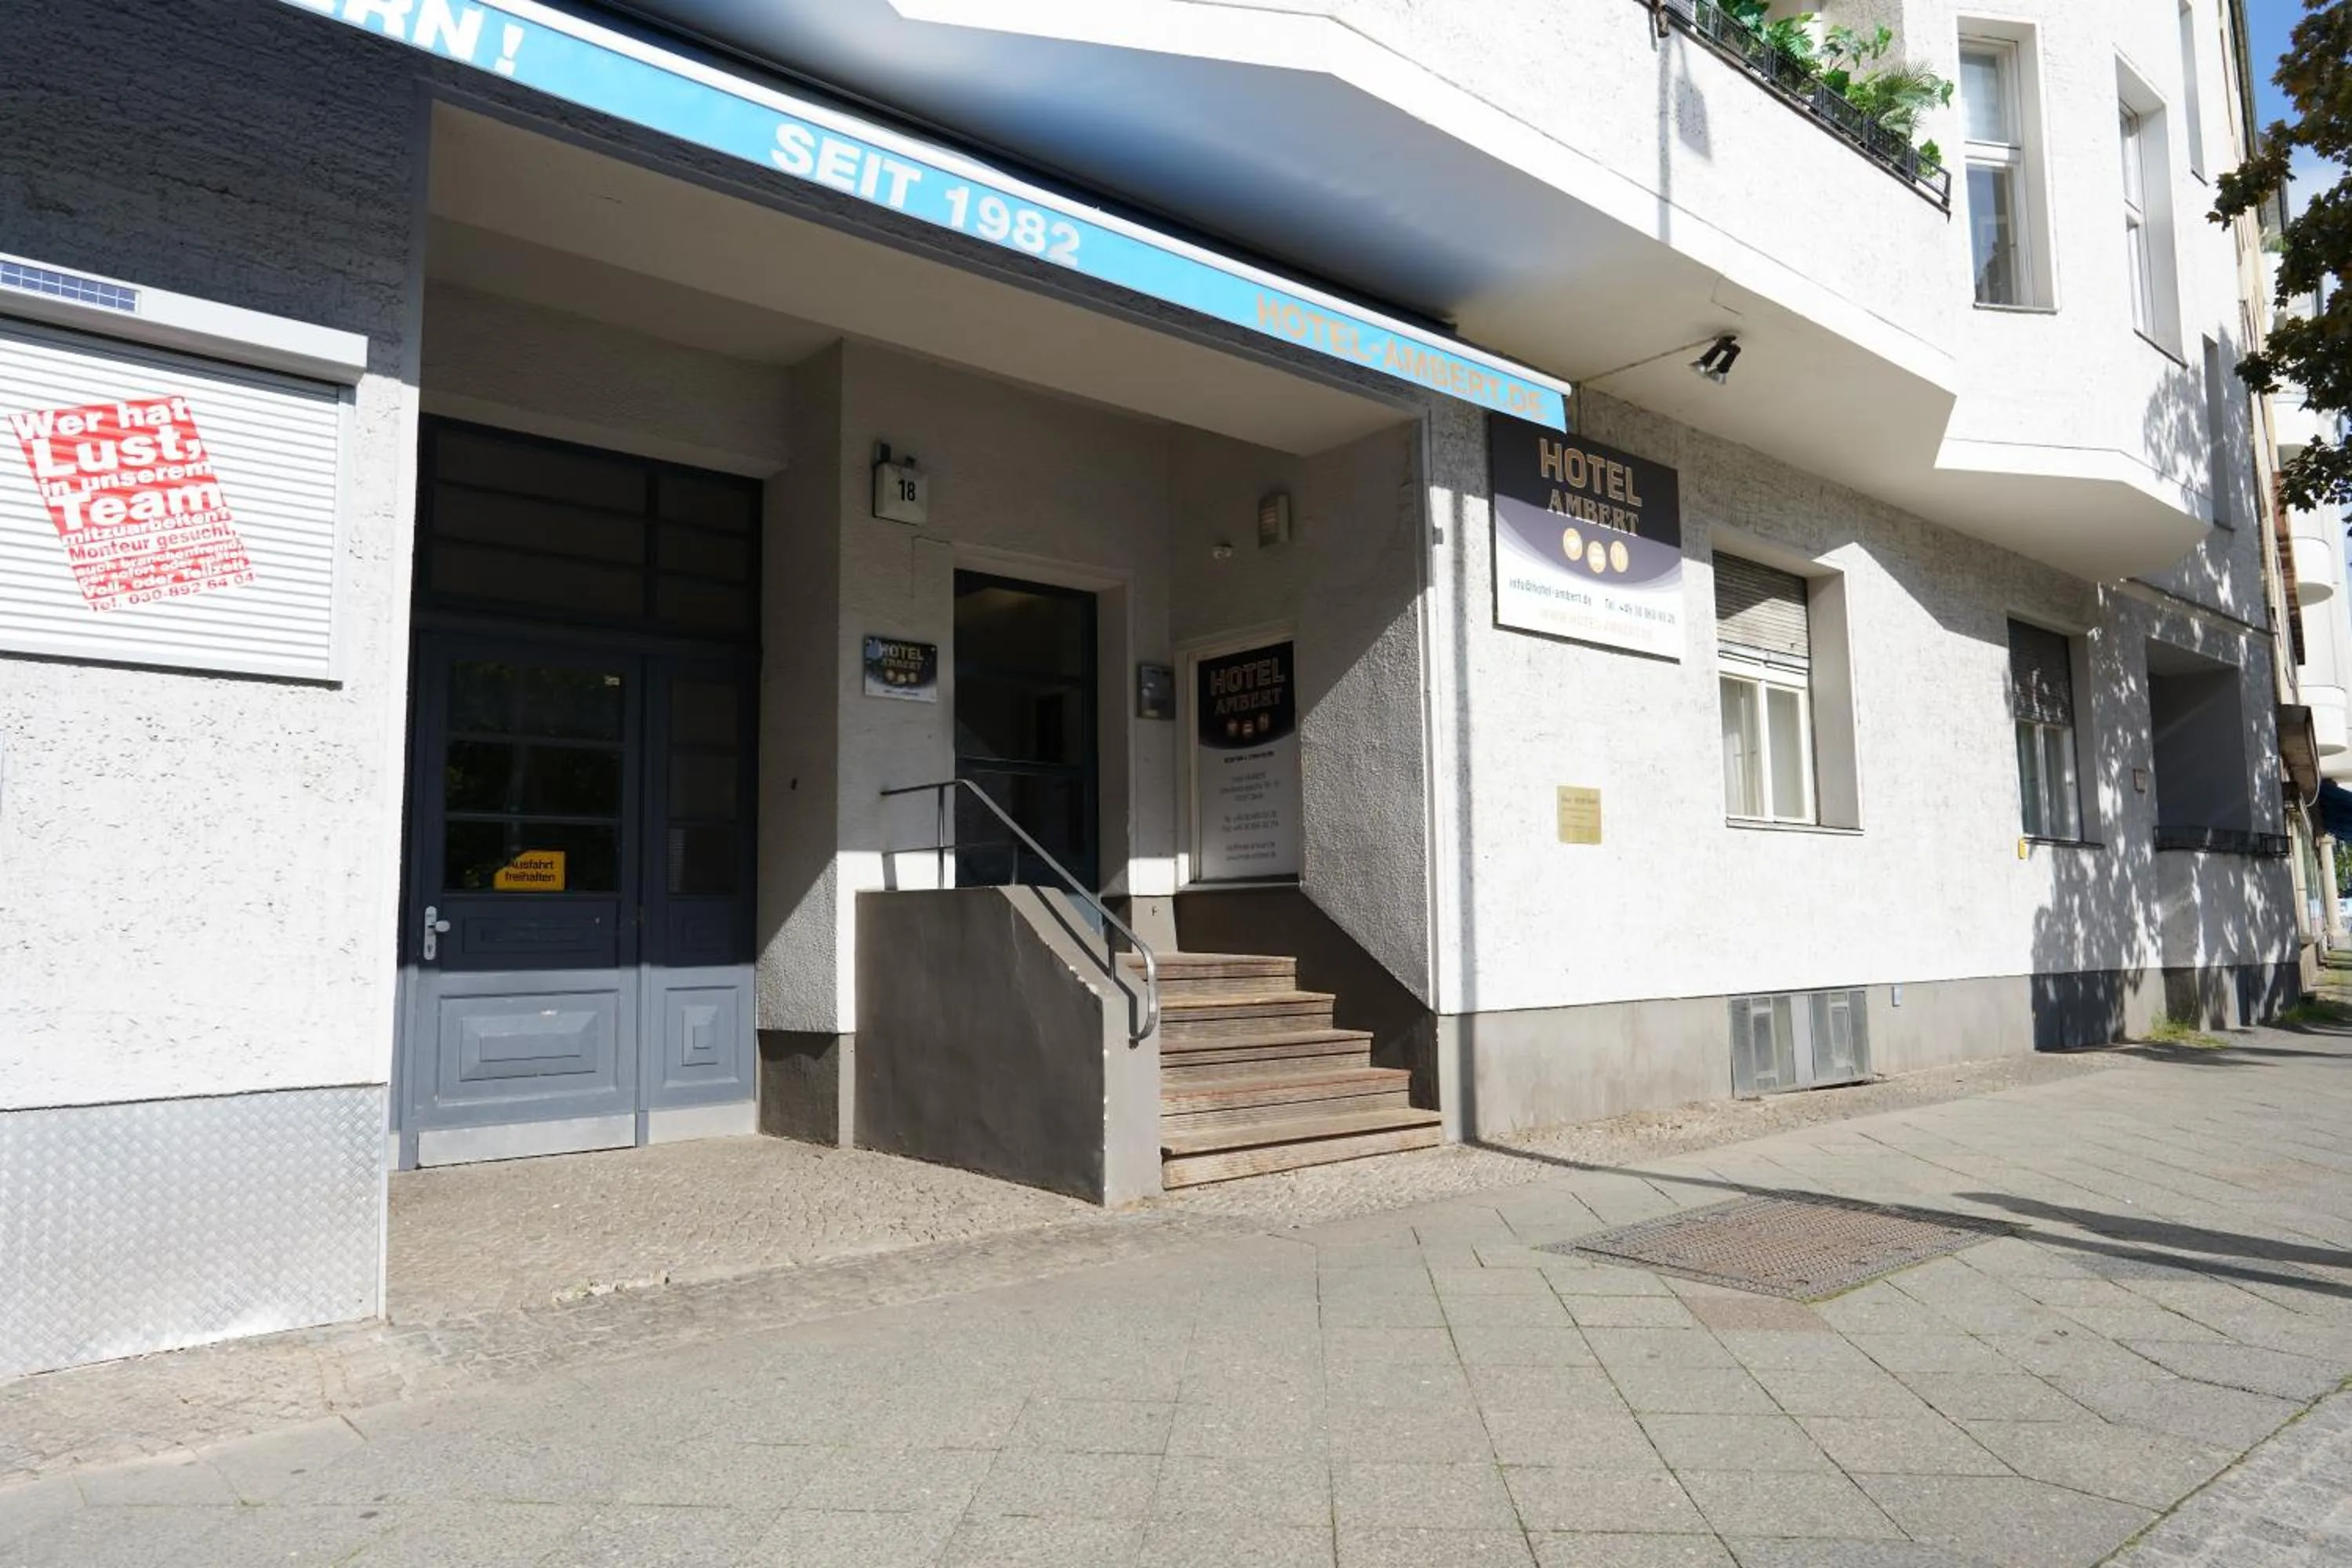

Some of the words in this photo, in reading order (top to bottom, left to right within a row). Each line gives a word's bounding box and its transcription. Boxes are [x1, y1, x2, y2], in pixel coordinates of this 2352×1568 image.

[770, 122, 921, 209] SEIT
[945, 186, 1080, 267] 1982
[1257, 292, 1549, 420] HOTEL-AMBERT.DE
[9, 410, 103, 440] Wer
[117, 396, 188, 428] hat
[32, 425, 202, 477] Lust,
[39, 477, 70, 498] in
[82, 461, 213, 492] unserem
[898, 480, 916, 502] 18
[1539, 437, 1642, 507] HOTEL
[47, 482, 224, 531] Team
[1547, 488, 1642, 536] AMBERT
[69, 539, 150, 561] Monteur
[132, 574, 174, 590] oder
[878, 643, 924, 661] HOTEL
[1210, 657, 1287, 697] HOTEL
[1214, 687, 1283, 717] AMBERT
[505, 871, 555, 883] freihalten
